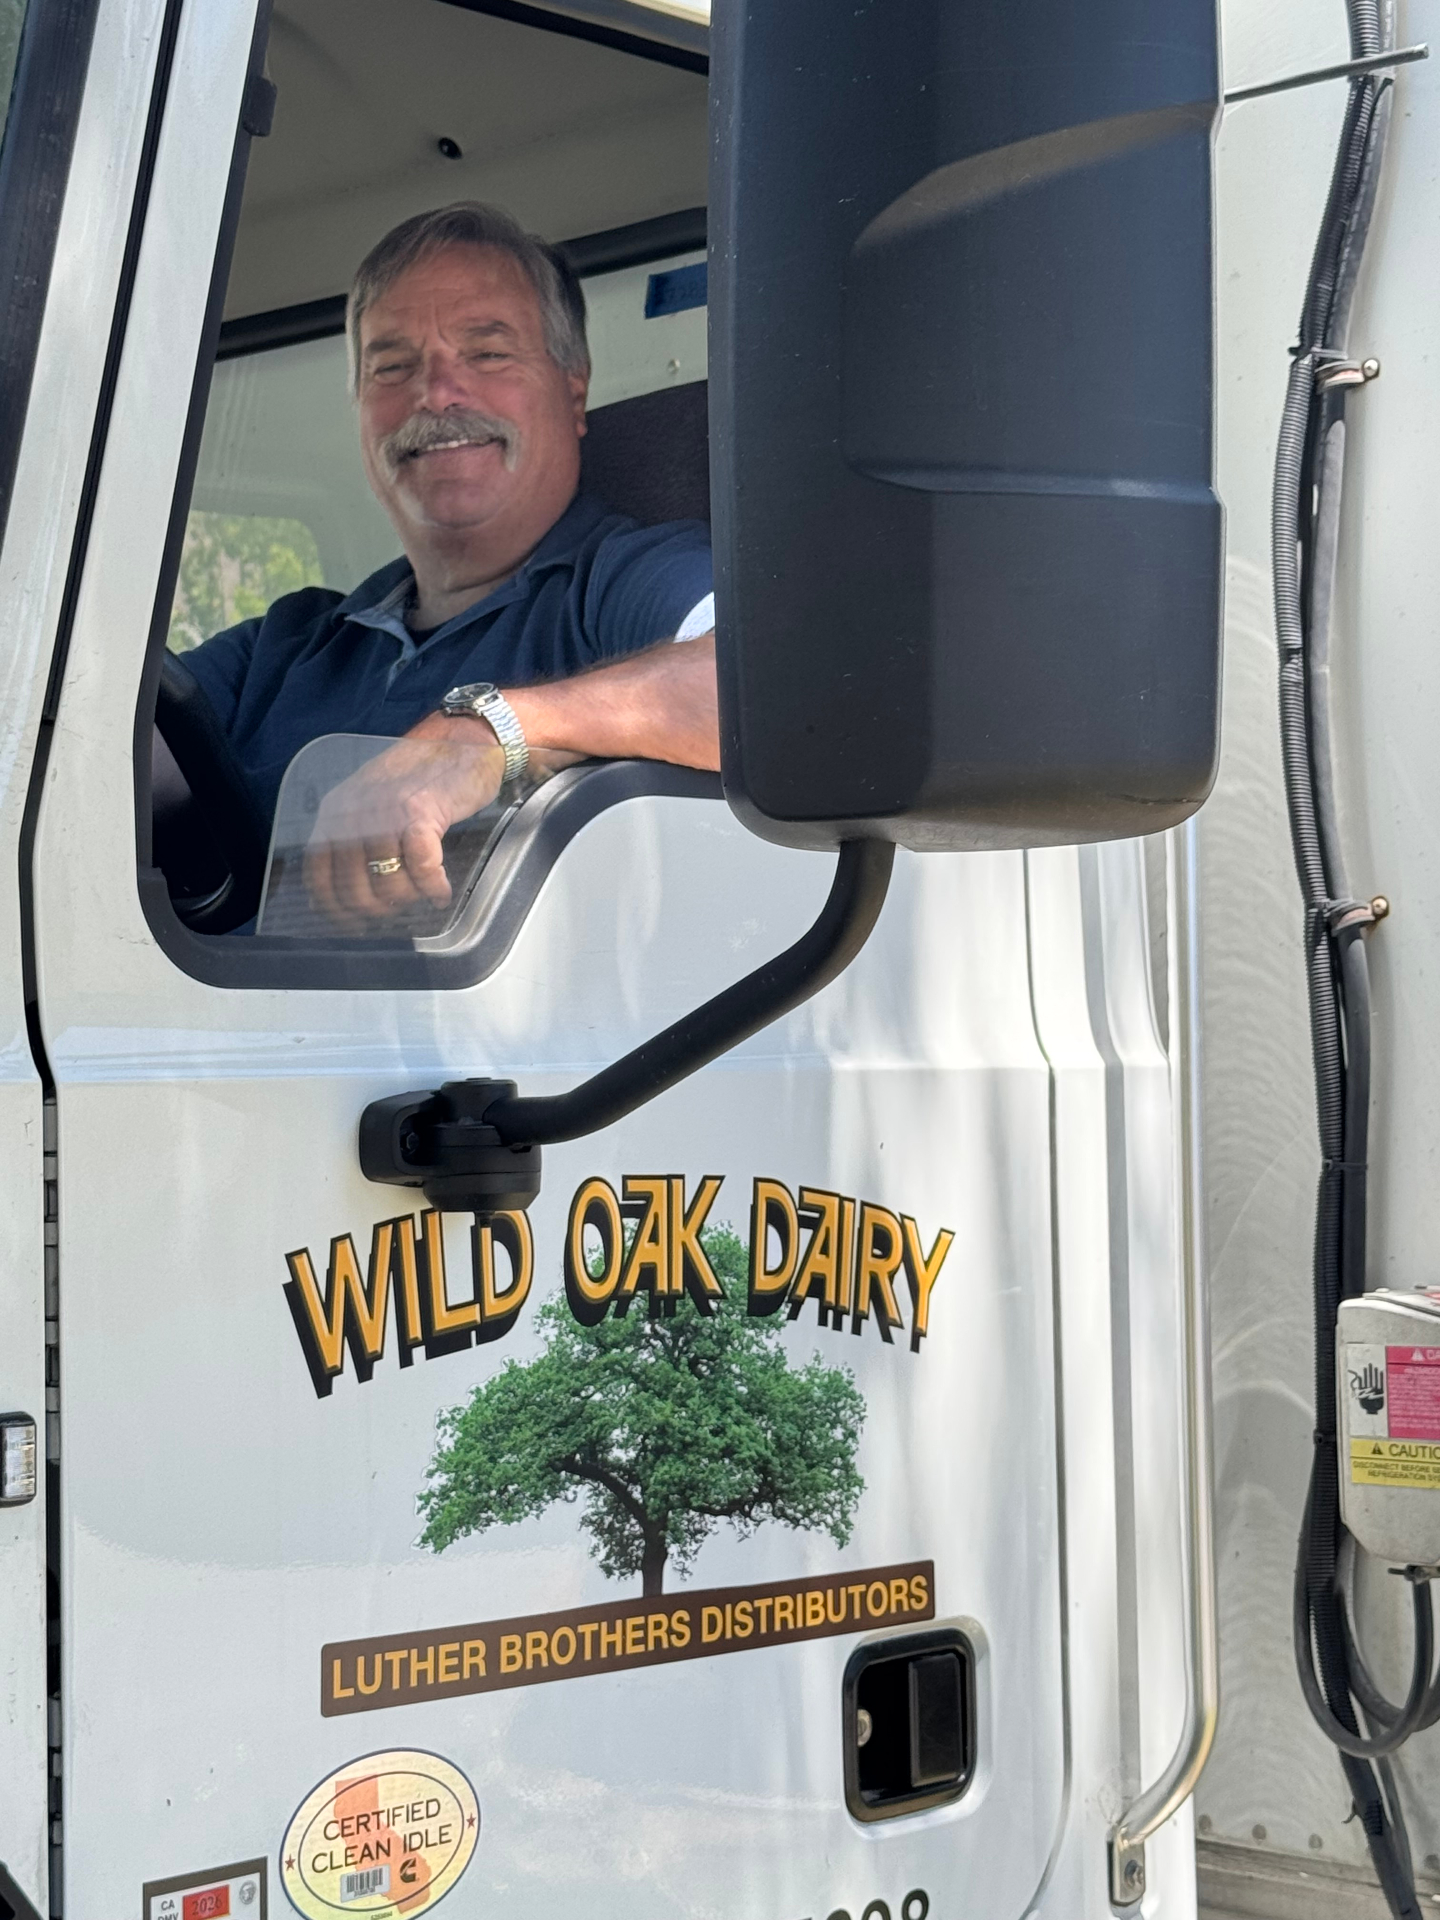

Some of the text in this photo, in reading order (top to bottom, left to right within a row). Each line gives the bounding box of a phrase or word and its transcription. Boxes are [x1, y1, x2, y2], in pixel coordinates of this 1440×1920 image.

[282, 1174, 956, 1399] WILD OAK DAIRY
[332, 1574, 929, 1699] LUTHER BROTHERS DISTRIBUTORS
[323, 1797, 441, 1841] CERTIFIED
[311, 1823, 453, 1873] CLEAN IDLE
[161, 1898, 176, 1911] CA
